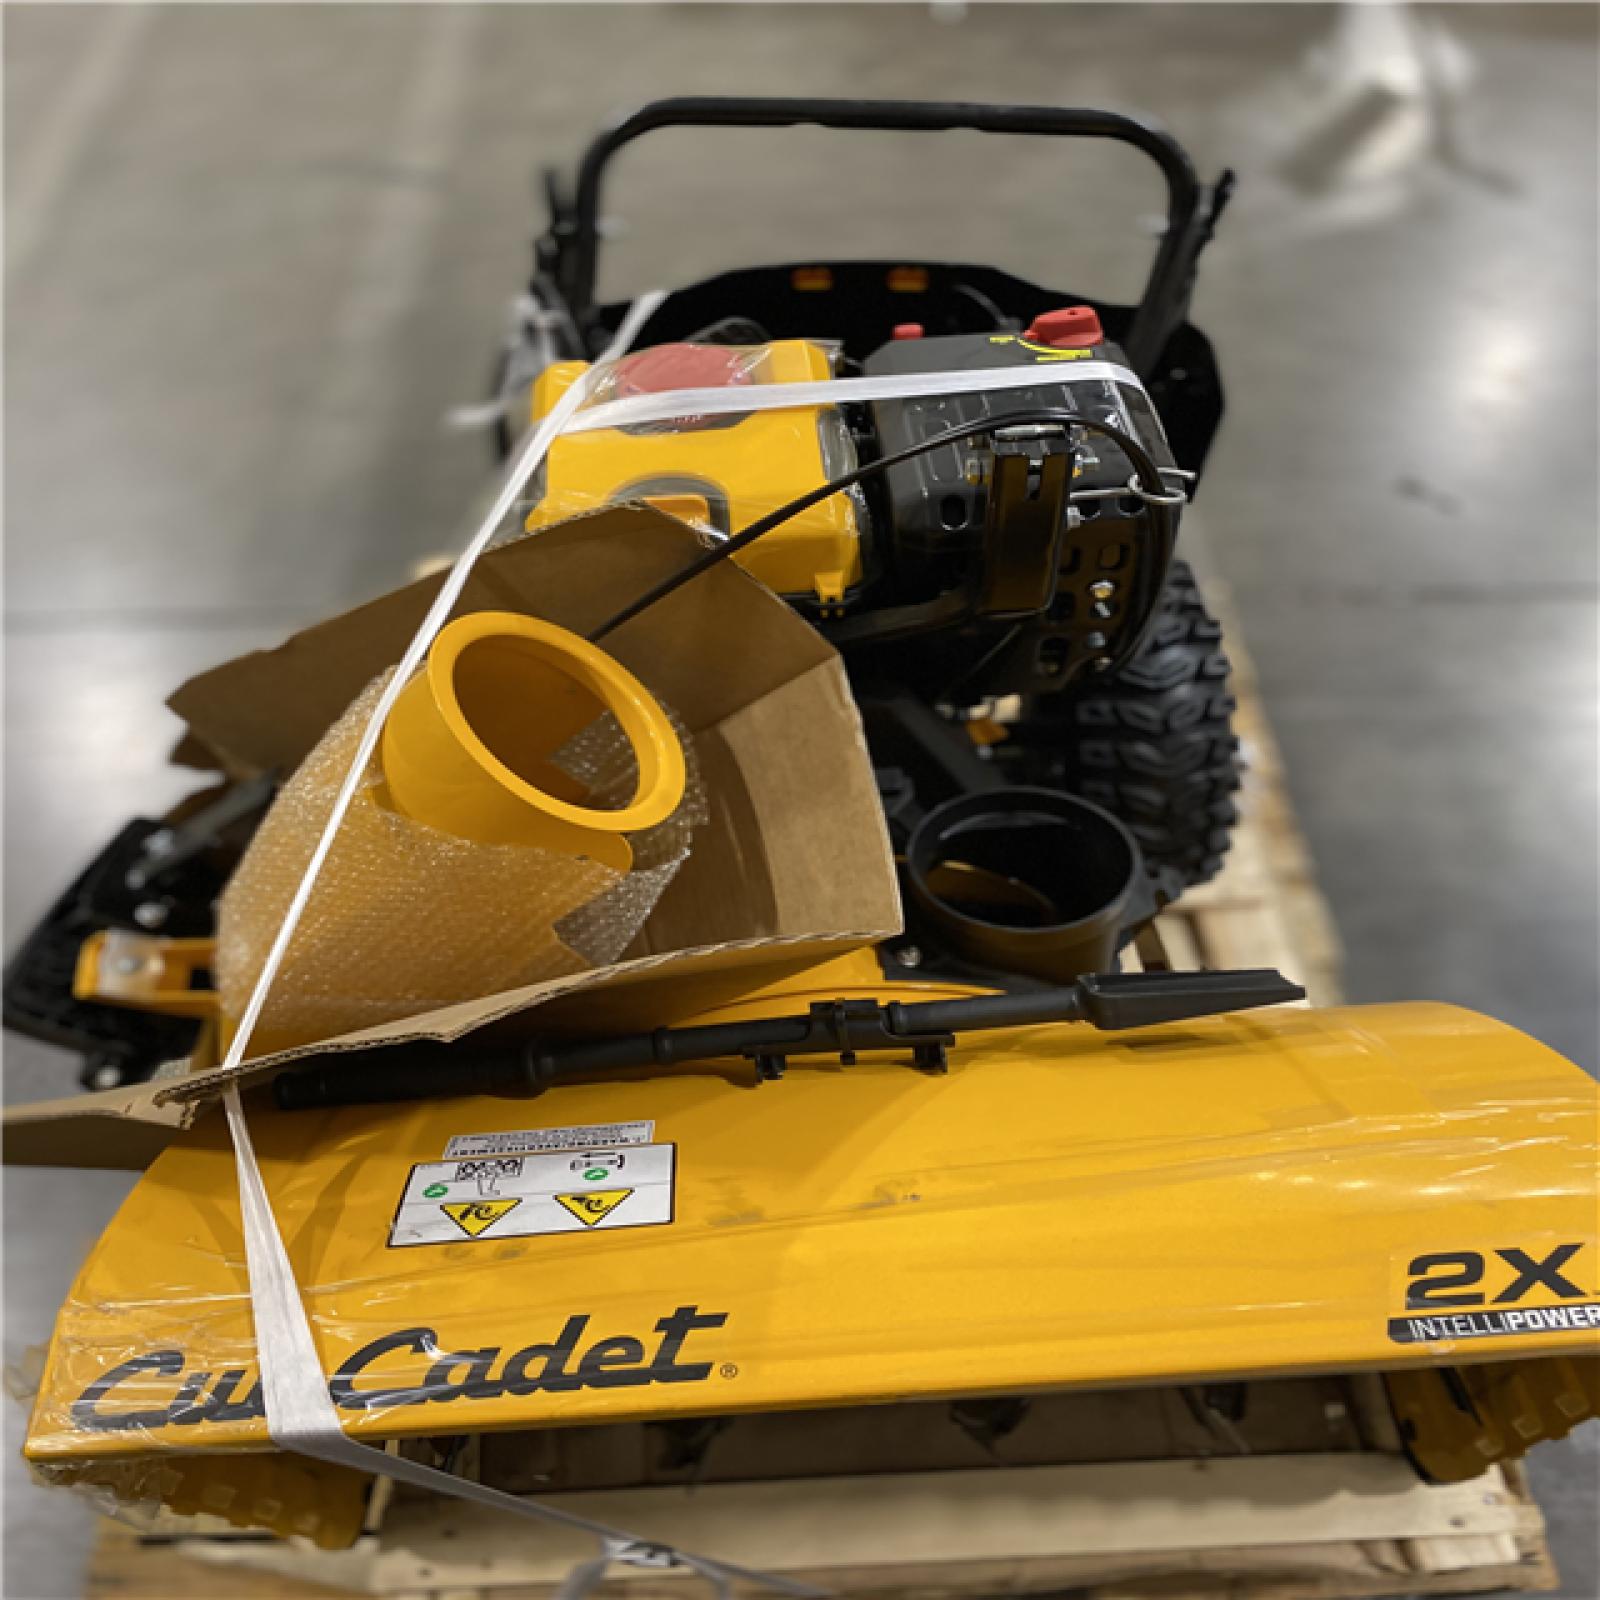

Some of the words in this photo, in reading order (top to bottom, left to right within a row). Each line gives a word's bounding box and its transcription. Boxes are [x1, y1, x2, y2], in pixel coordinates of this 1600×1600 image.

[1405, 1242, 1587, 1310] 2X
[70, 1349, 268, 1432] Cu
[328, 1305, 729, 1410] Cadet
